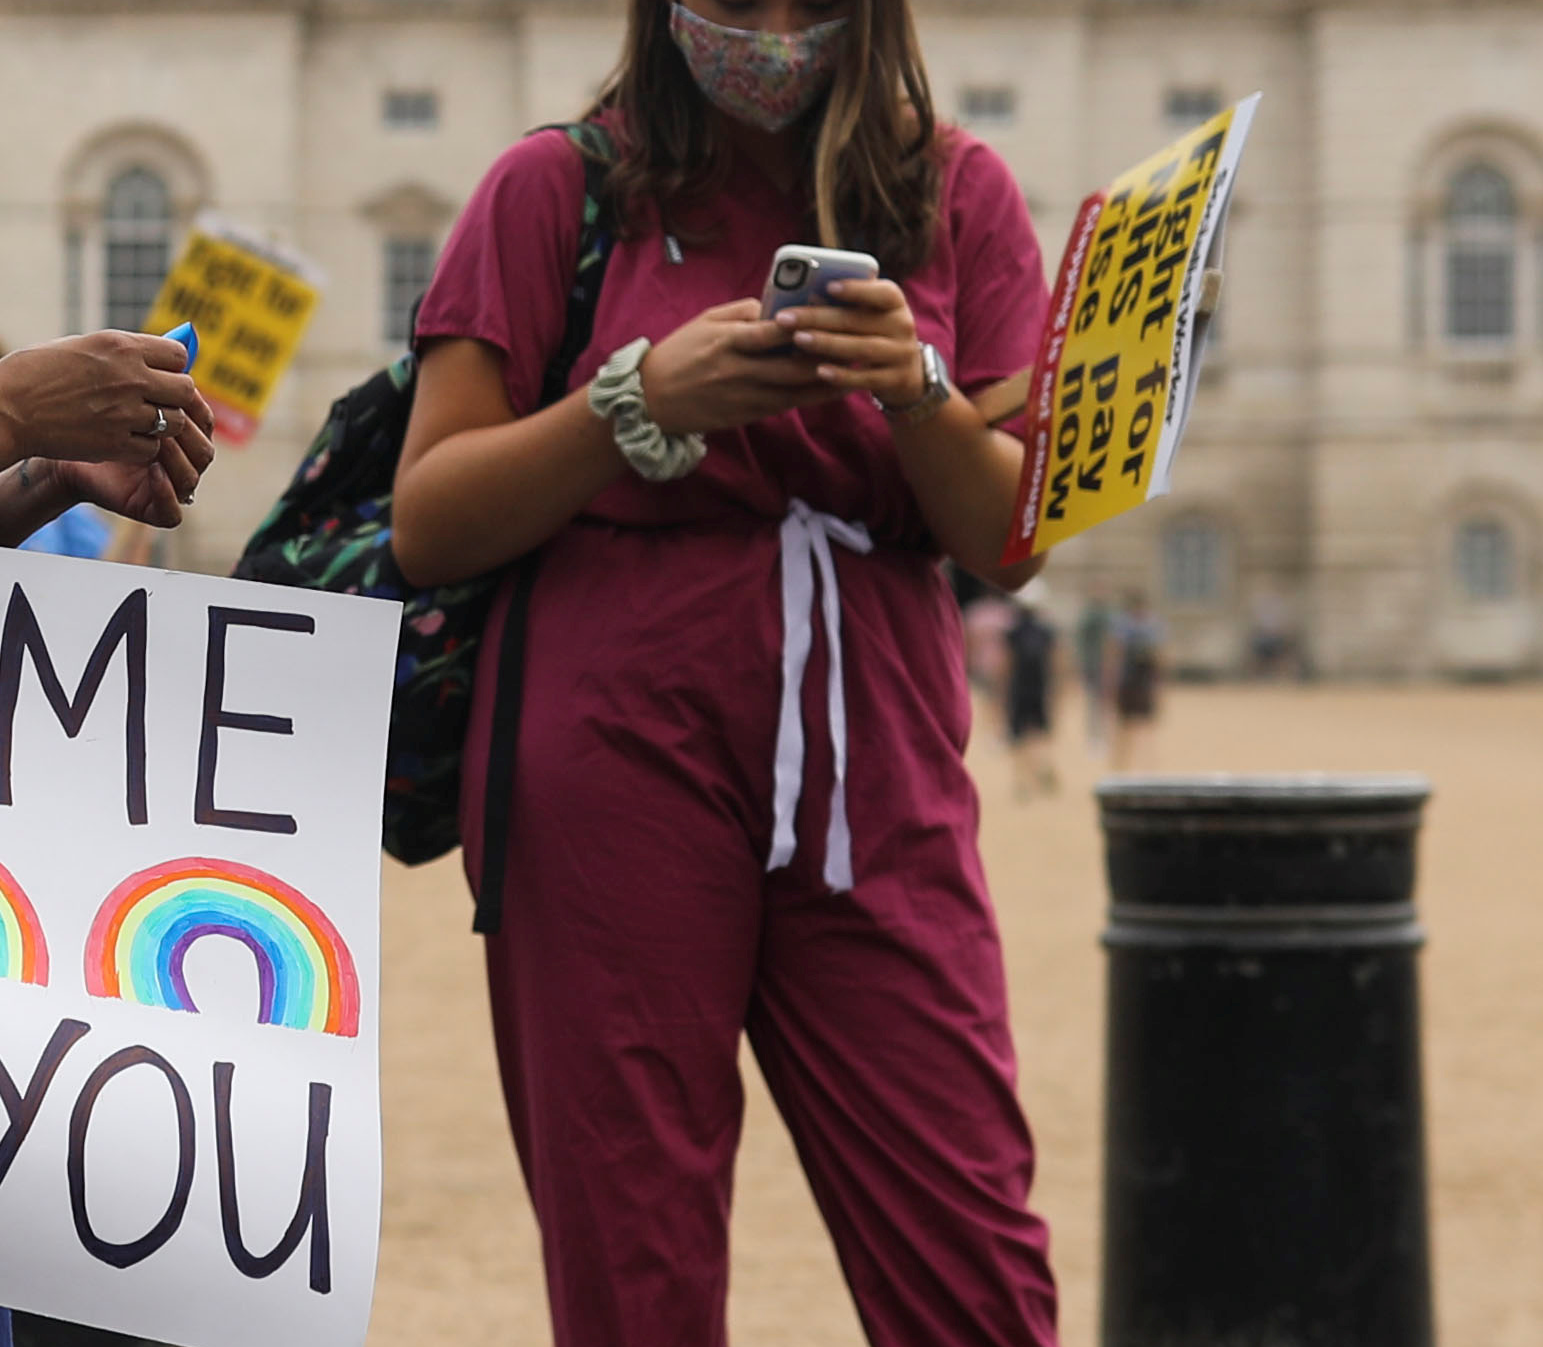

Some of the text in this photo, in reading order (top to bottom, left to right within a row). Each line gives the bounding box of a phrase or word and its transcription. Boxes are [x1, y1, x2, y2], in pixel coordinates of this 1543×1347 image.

[1045, 188, 1133, 521] rise now
[1077, 158, 1181, 492] NHS pay
[1121, 129, 1226, 486] Fight for
